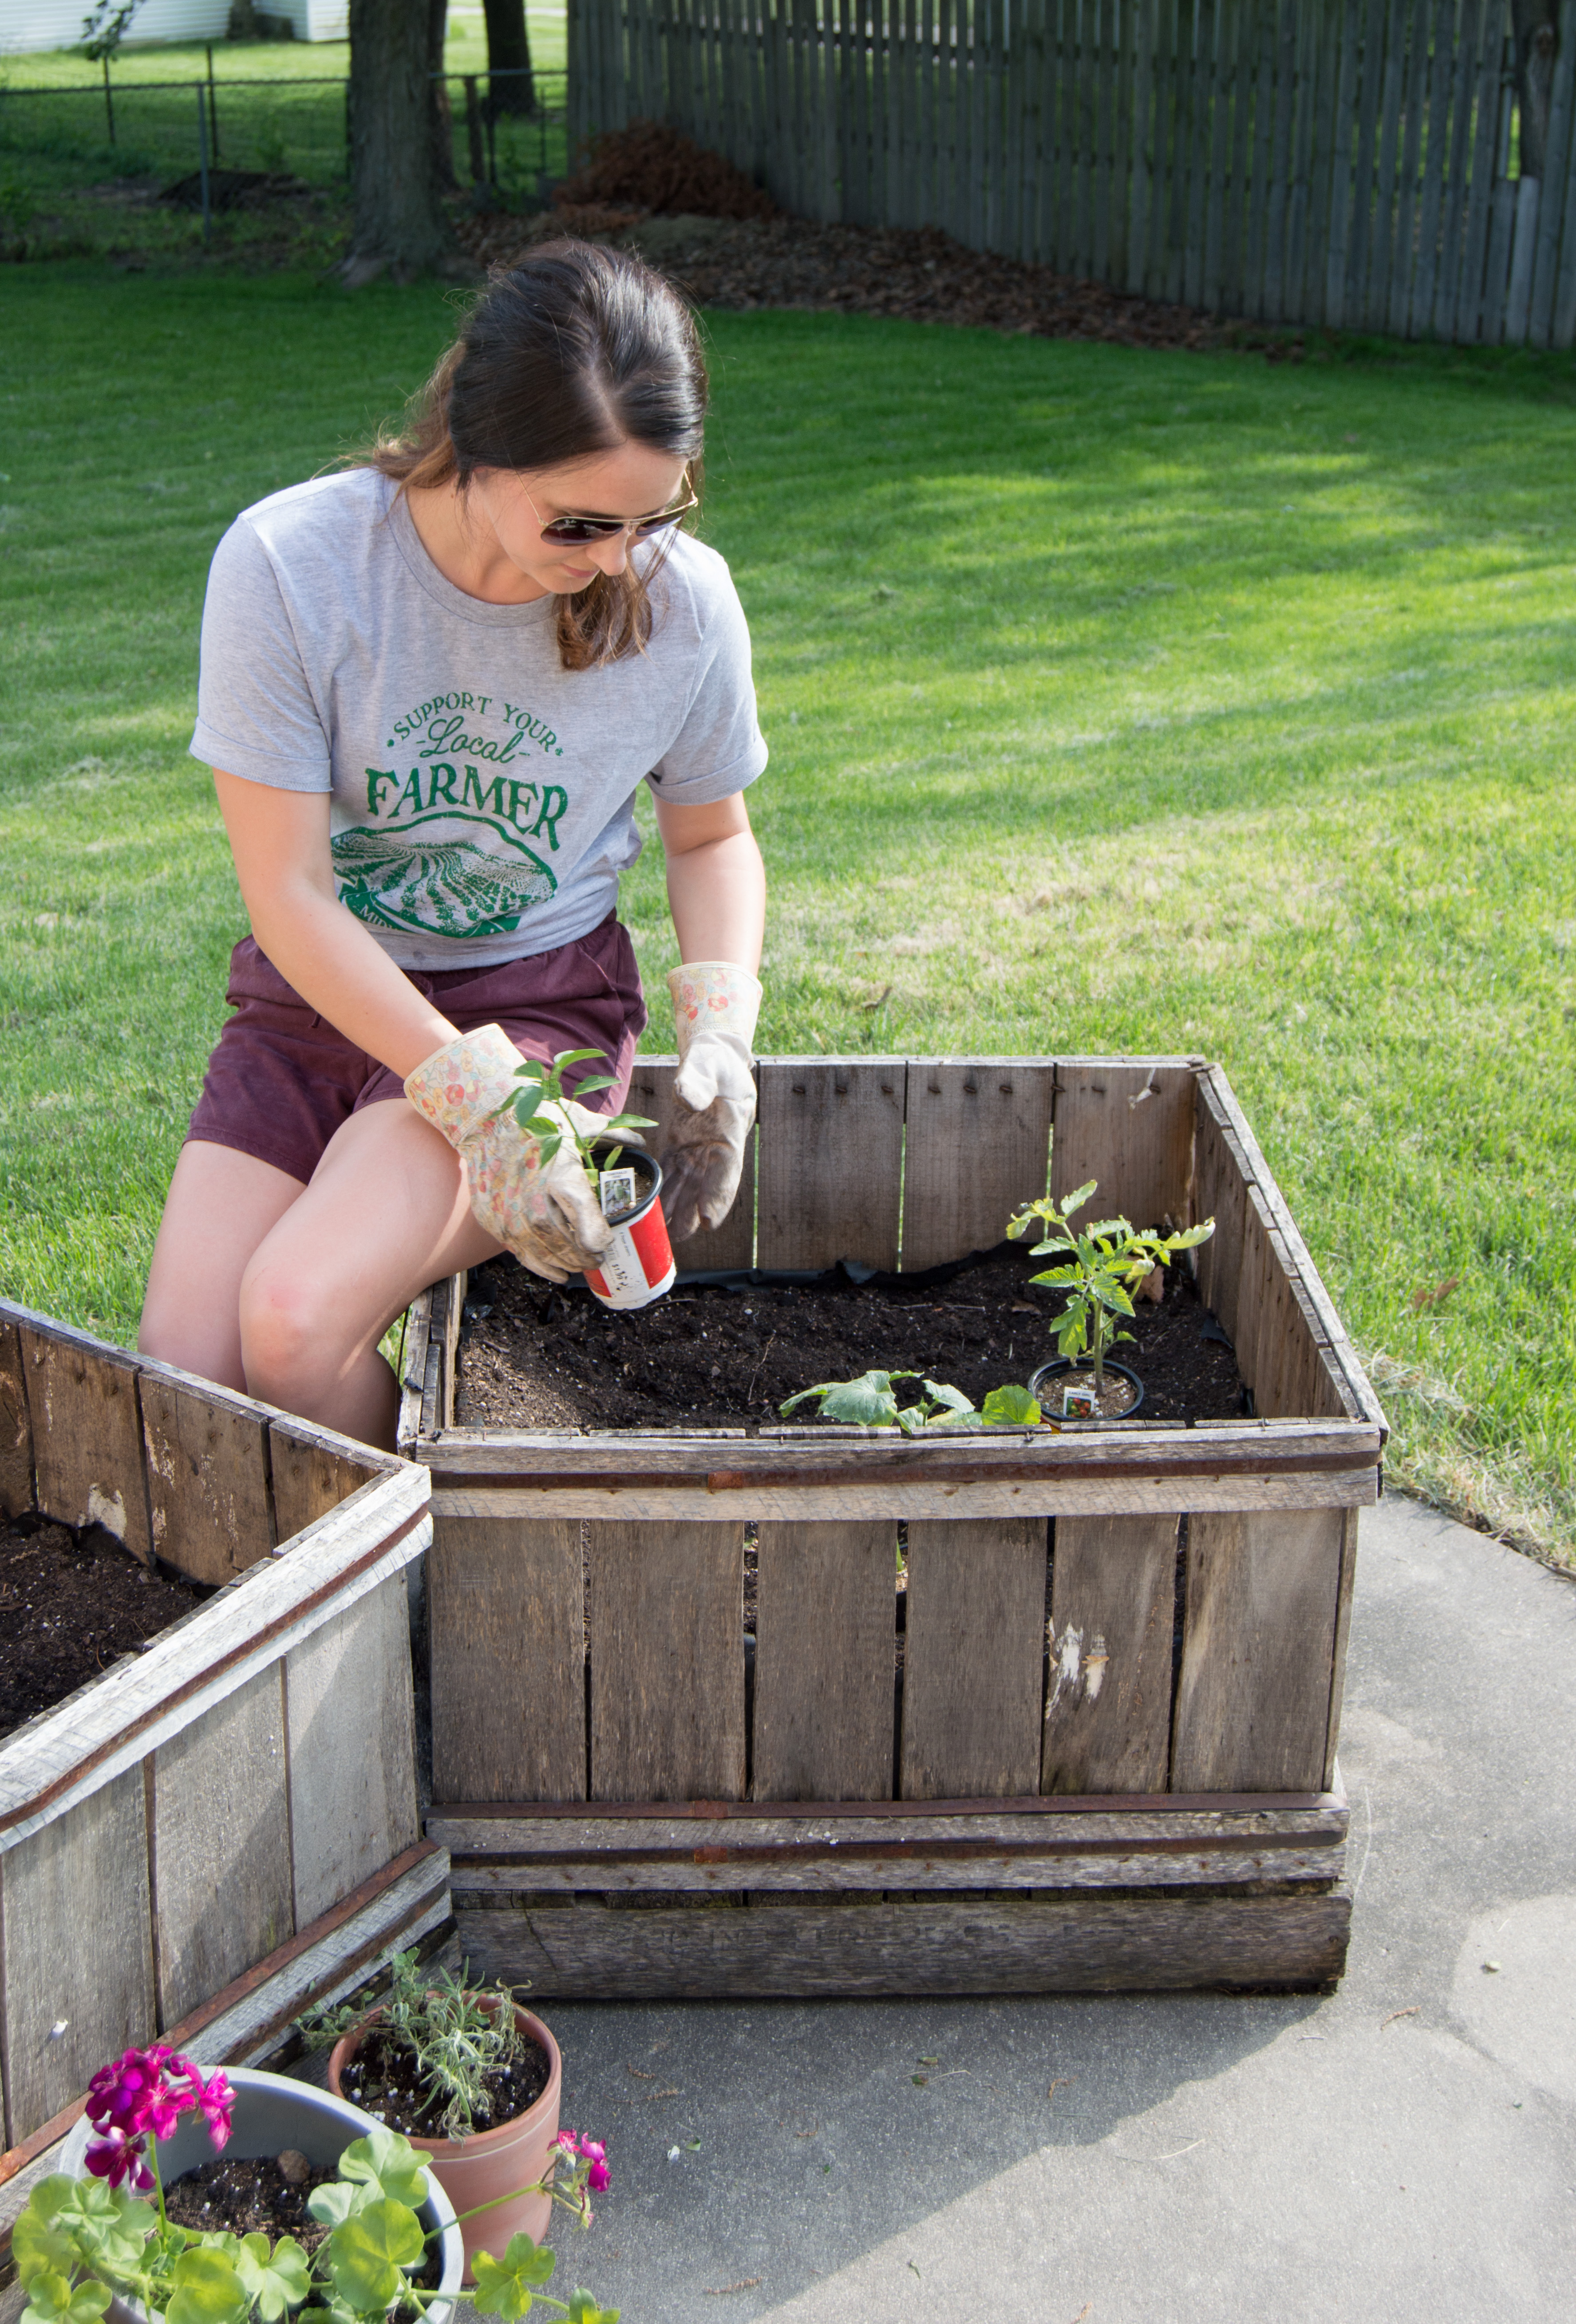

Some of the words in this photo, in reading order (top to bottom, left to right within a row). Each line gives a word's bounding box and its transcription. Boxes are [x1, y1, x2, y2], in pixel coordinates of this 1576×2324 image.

[394, 692, 492, 740] SUPPORT
[503, 703, 557, 752] YOUR
[365, 763, 568, 851] FARMER
